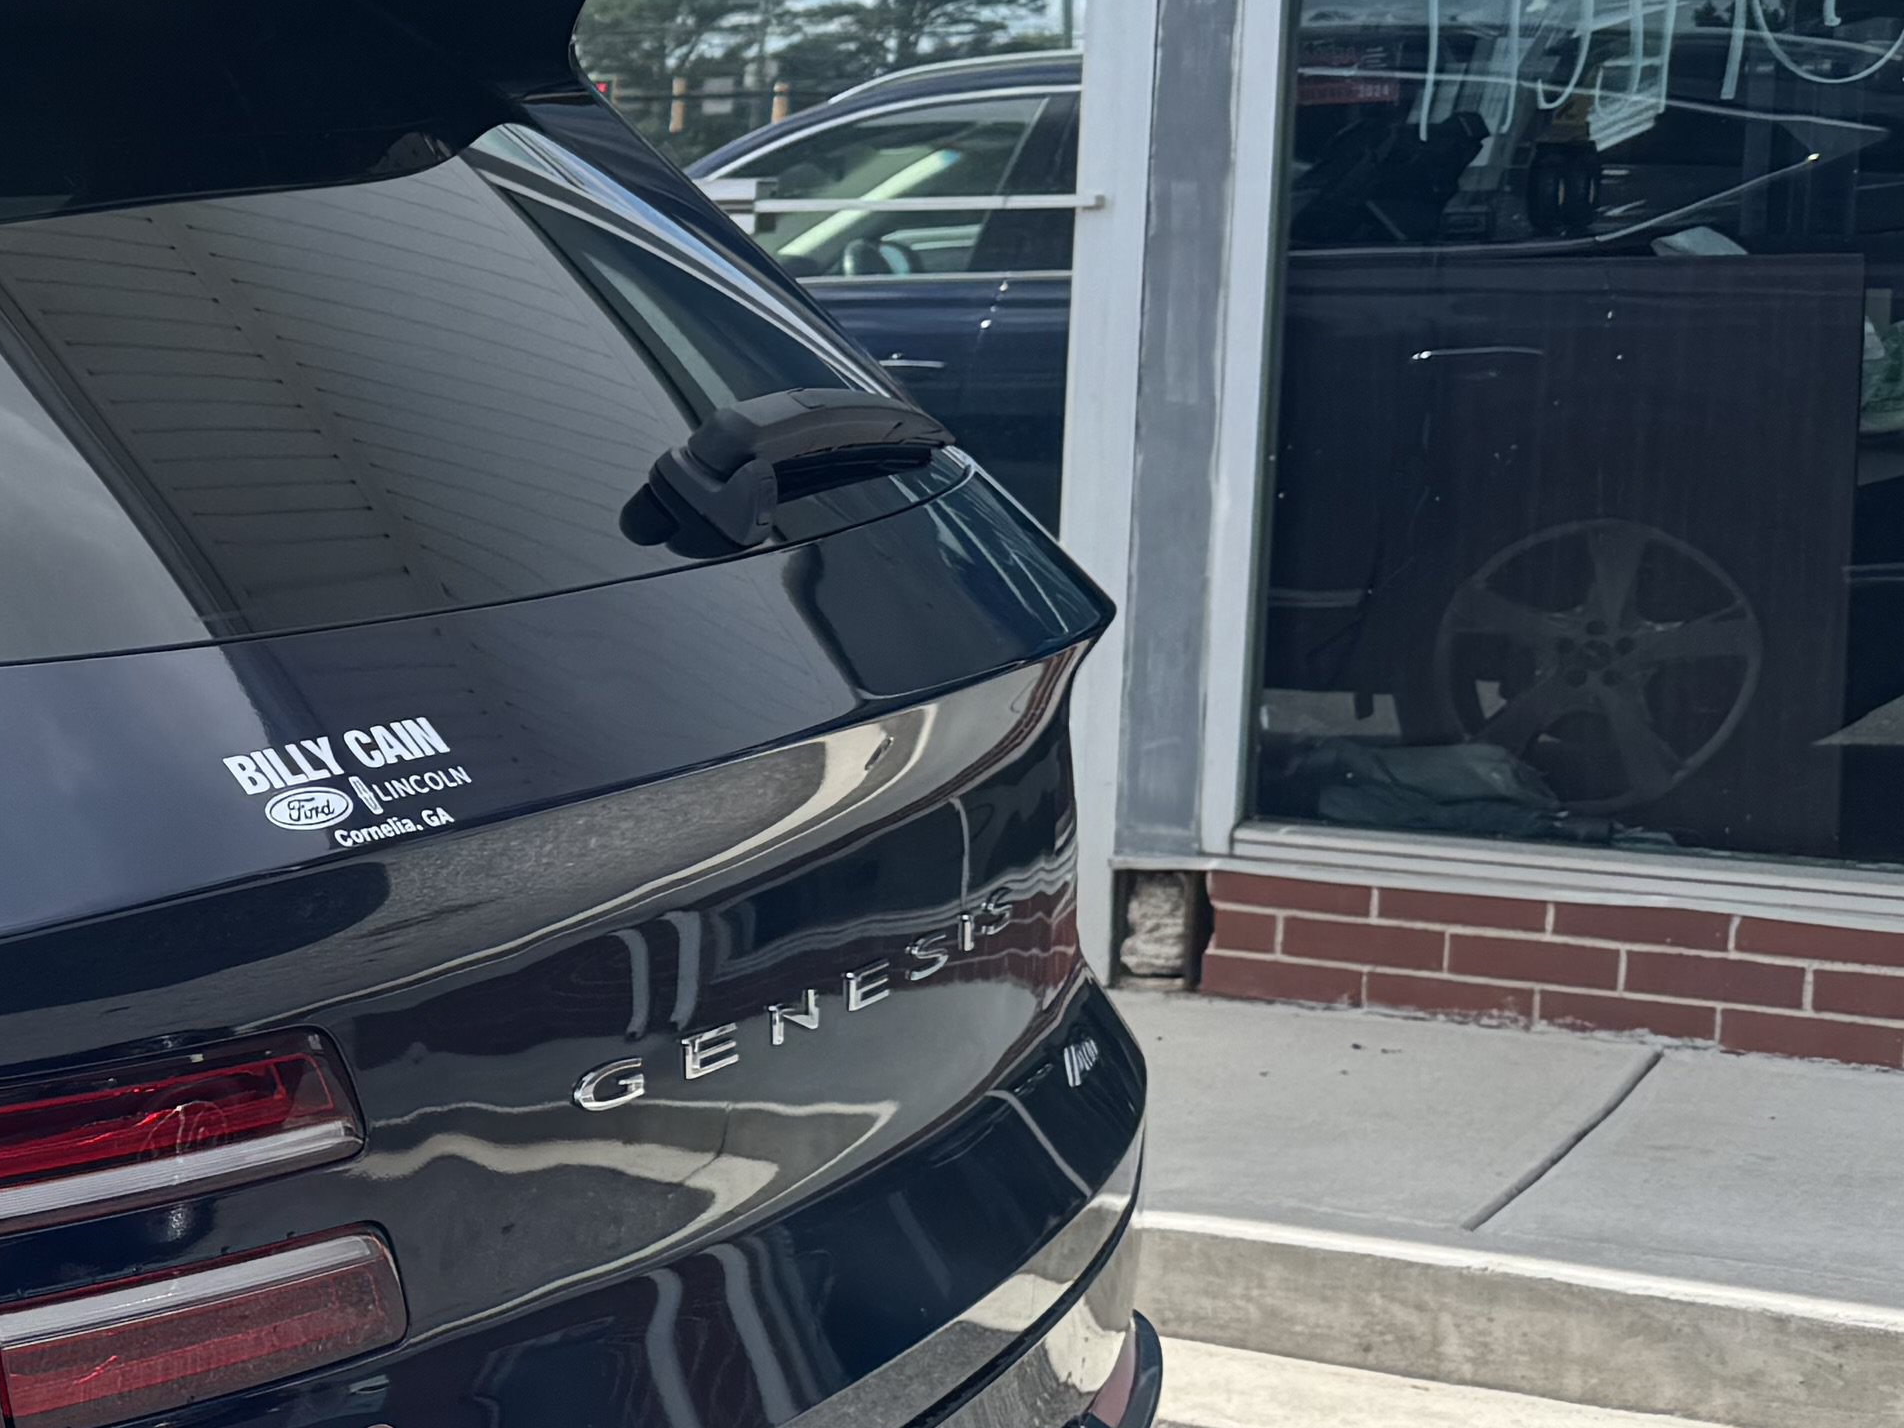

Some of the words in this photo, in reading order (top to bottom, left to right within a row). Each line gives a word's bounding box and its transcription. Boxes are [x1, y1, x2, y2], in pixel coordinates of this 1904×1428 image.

[223, 736, 345, 795] BILLY
[343, 716, 451, 769] CAIN
[287, 797, 335, 822] Ford
[372, 766, 472, 801] LINCOLN
[421, 807, 455, 827] GA
[572, 886, 1012, 1111] GENESIS
